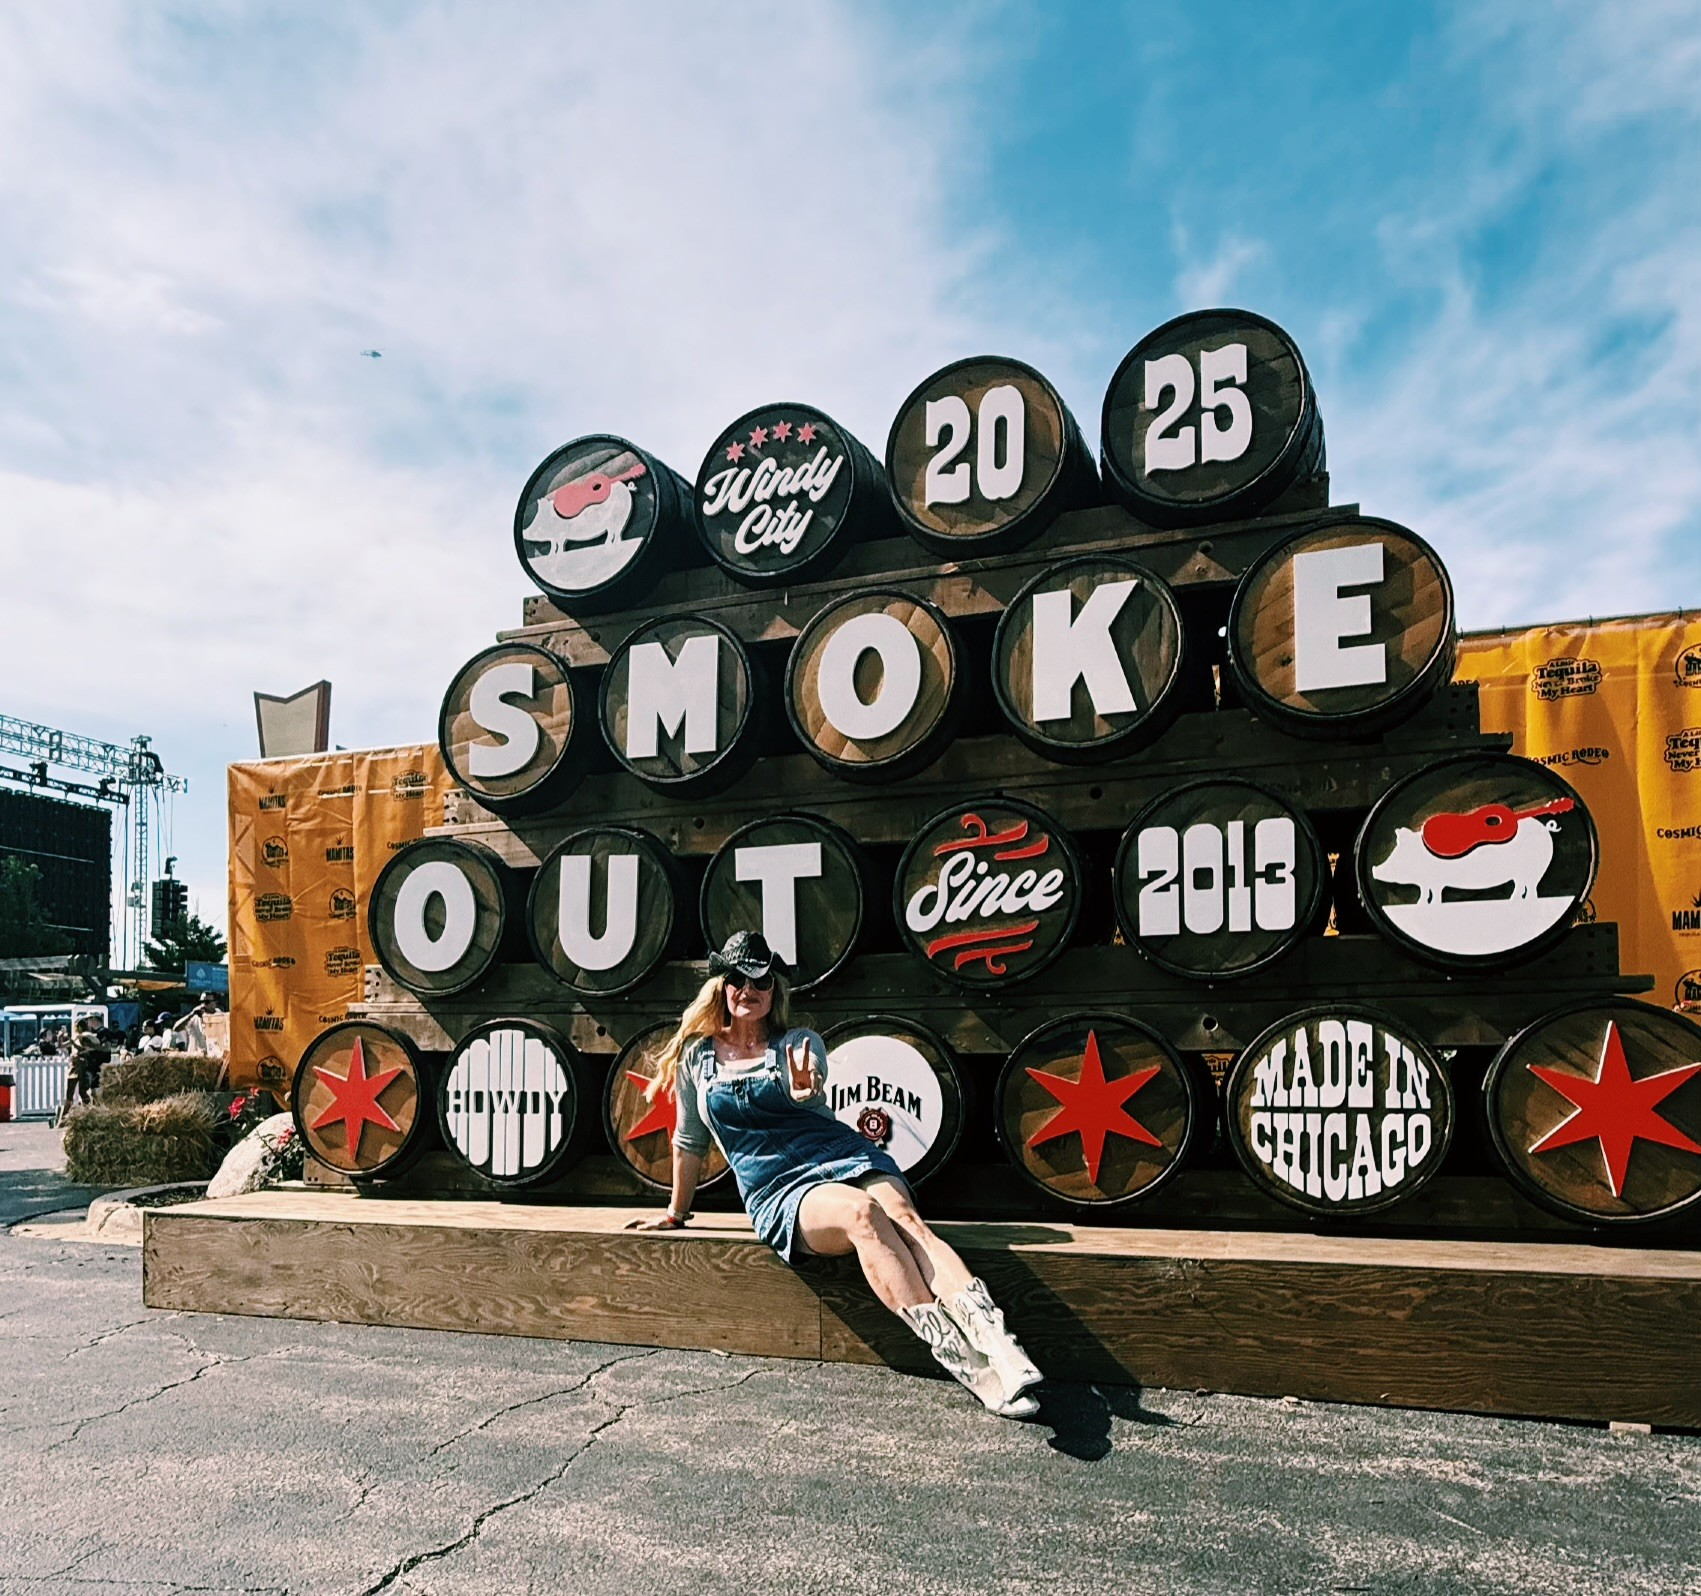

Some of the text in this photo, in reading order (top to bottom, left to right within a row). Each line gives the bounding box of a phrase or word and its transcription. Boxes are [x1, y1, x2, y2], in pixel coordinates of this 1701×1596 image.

[925, 384, 1025, 509] 20
[1145, 343, 1253, 477] 25
[703, 445, 844, 516] Windy
[735, 500, 814, 554] City
[469, 542, 1387, 778] SMOKE
[1537, 661, 1598, 680] Tequila
[1541, 684, 1592, 698] My Heart
[1571, 747, 1609, 764] RODEO
[1674, 759, 1692, 769] My
[394, 842, 822, 972] OUT
[905, 850, 1064, 933] Since
[1138, 817, 1296, 937] 2013
[328, 952, 361, 962] Tequila
[446, 1029, 568, 1176] HOWDY
[831, 1075, 922, 1122] JIM BEAM
[1250, 1020, 1432, 1109] MADE IN
[1250, 1111, 1432, 1201] CHICAGO
